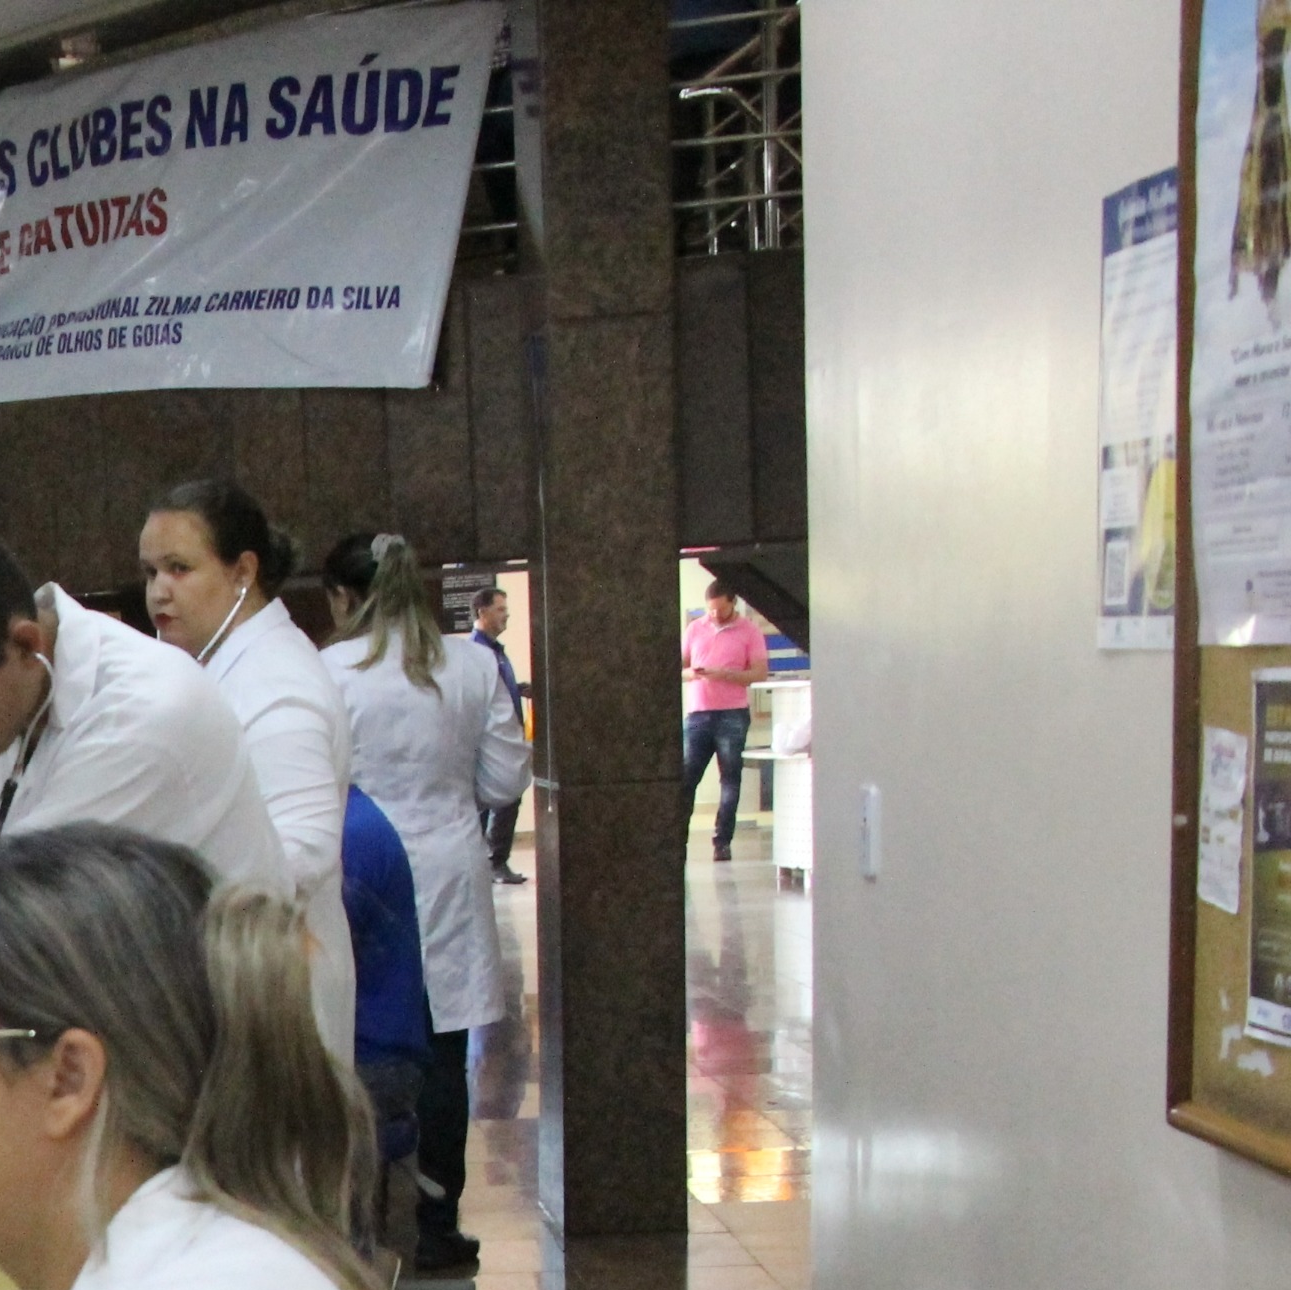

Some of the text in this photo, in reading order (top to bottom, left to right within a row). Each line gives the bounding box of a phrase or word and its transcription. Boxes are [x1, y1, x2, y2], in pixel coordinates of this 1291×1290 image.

[27, 94, 172, 188] CLUBES
[185, 82, 249, 150] NA
[265, 53, 460, 140] SAÚDE
[144, 295, 202, 318] ZILMA
[204, 286, 301, 314] CARNEIRO
[306, 285, 334, 310] DA
[342, 284, 401, 310] SILVA
[35, 334, 55, 357] DE
[57, 327, 104, 355] OLHOS
[107, 325, 129, 349] DE
[132, 318, 184, 347] GOIÁS
